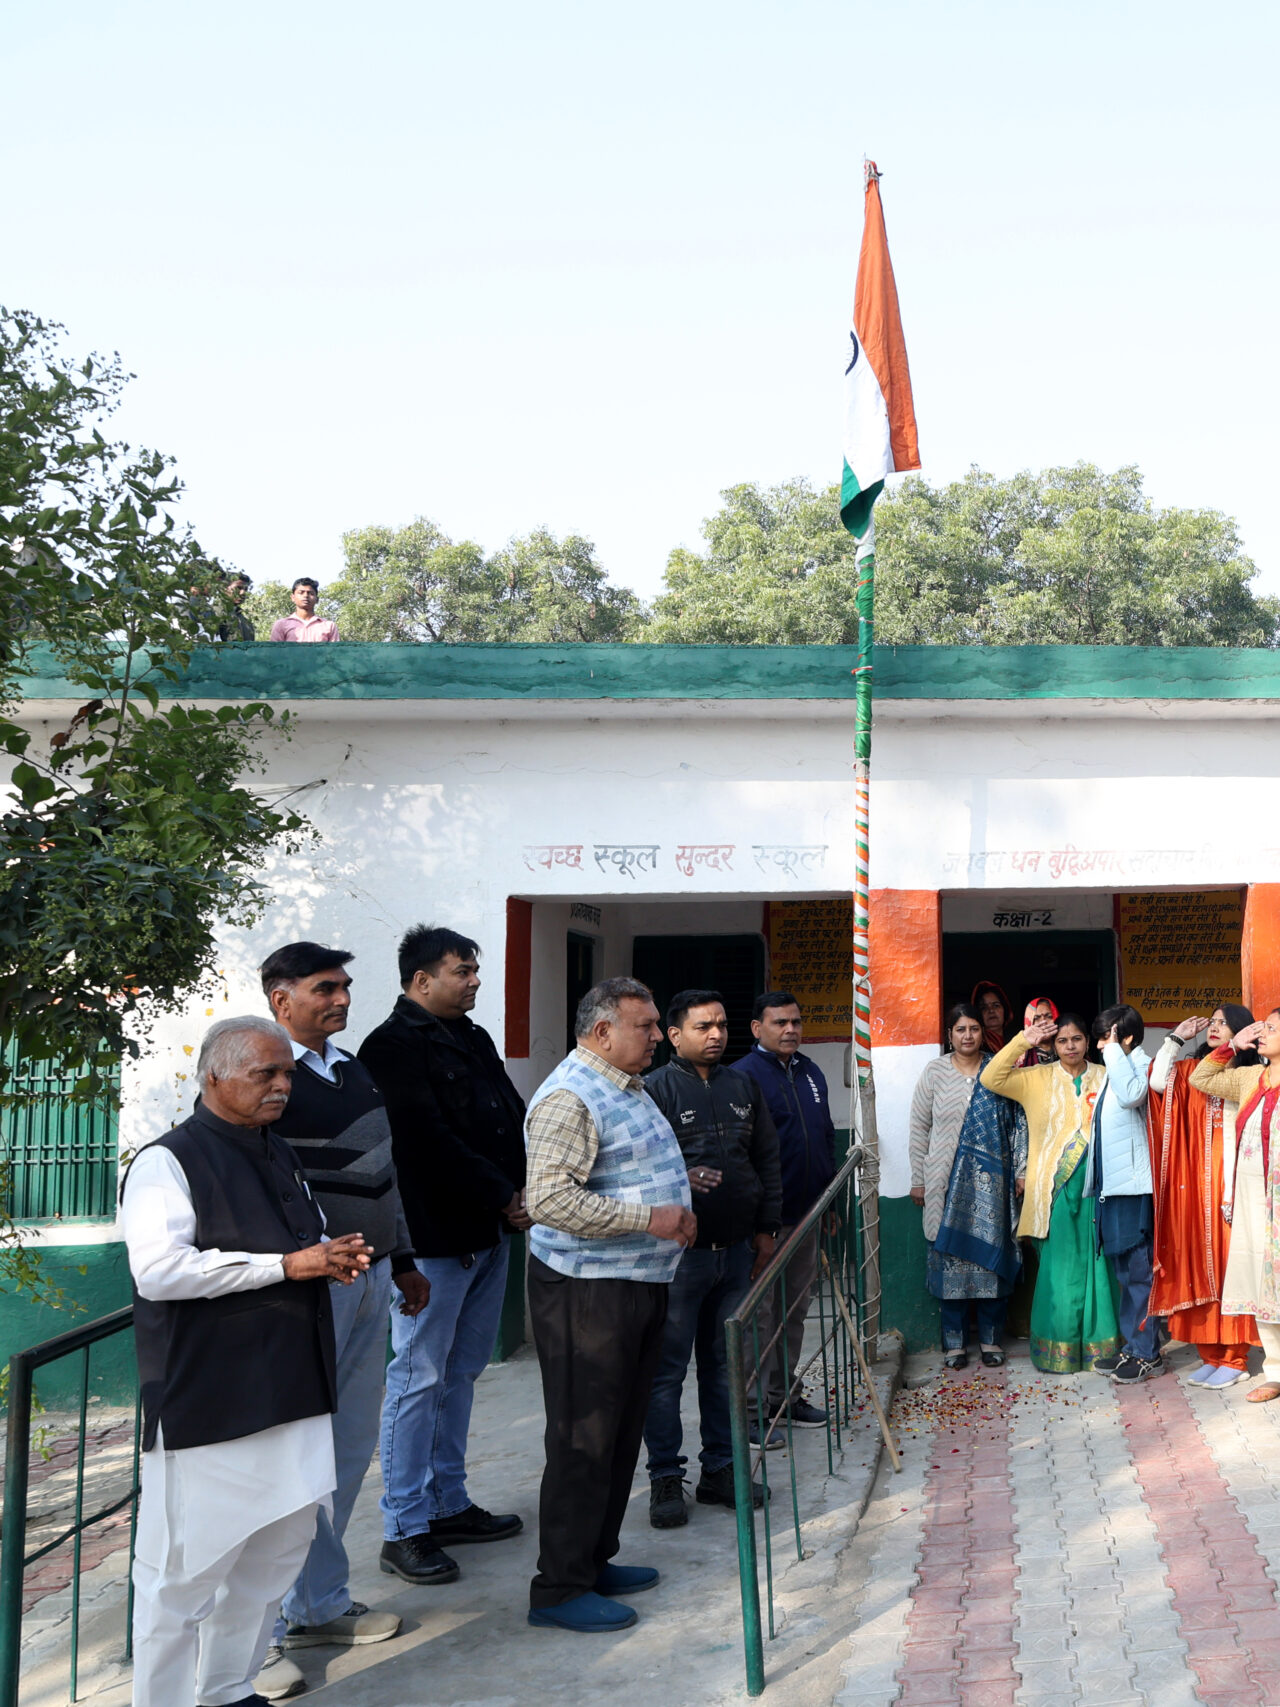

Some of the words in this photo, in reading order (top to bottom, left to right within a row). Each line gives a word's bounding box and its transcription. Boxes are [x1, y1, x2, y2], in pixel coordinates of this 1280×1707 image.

[593, 845, 661, 880] स्कूल
[675, 845, 736, 877] सुन्दर
[752, 845, 829, 879] स्कूल
